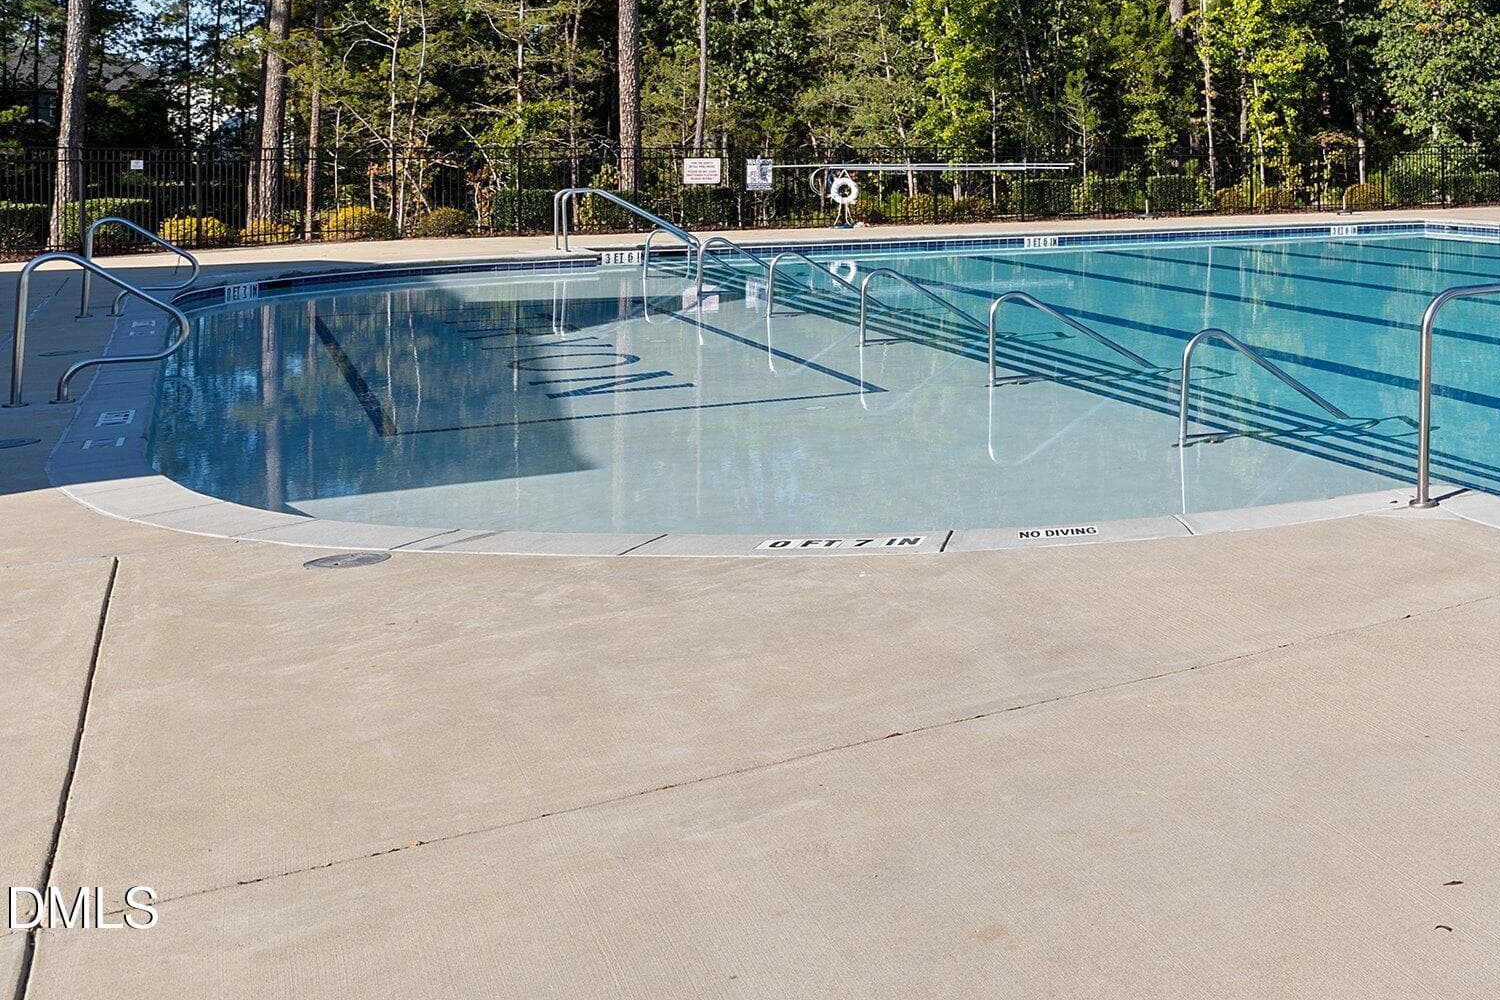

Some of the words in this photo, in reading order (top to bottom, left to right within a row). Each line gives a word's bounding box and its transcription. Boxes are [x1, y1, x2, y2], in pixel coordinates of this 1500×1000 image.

[1019, 530, 1041, 538] NO
[1045, 526, 1097, 537] DIVING
[769, 540, 792, 548] 0
[800, 539, 842, 548] FT
[885, 537, 921, 546] IN
